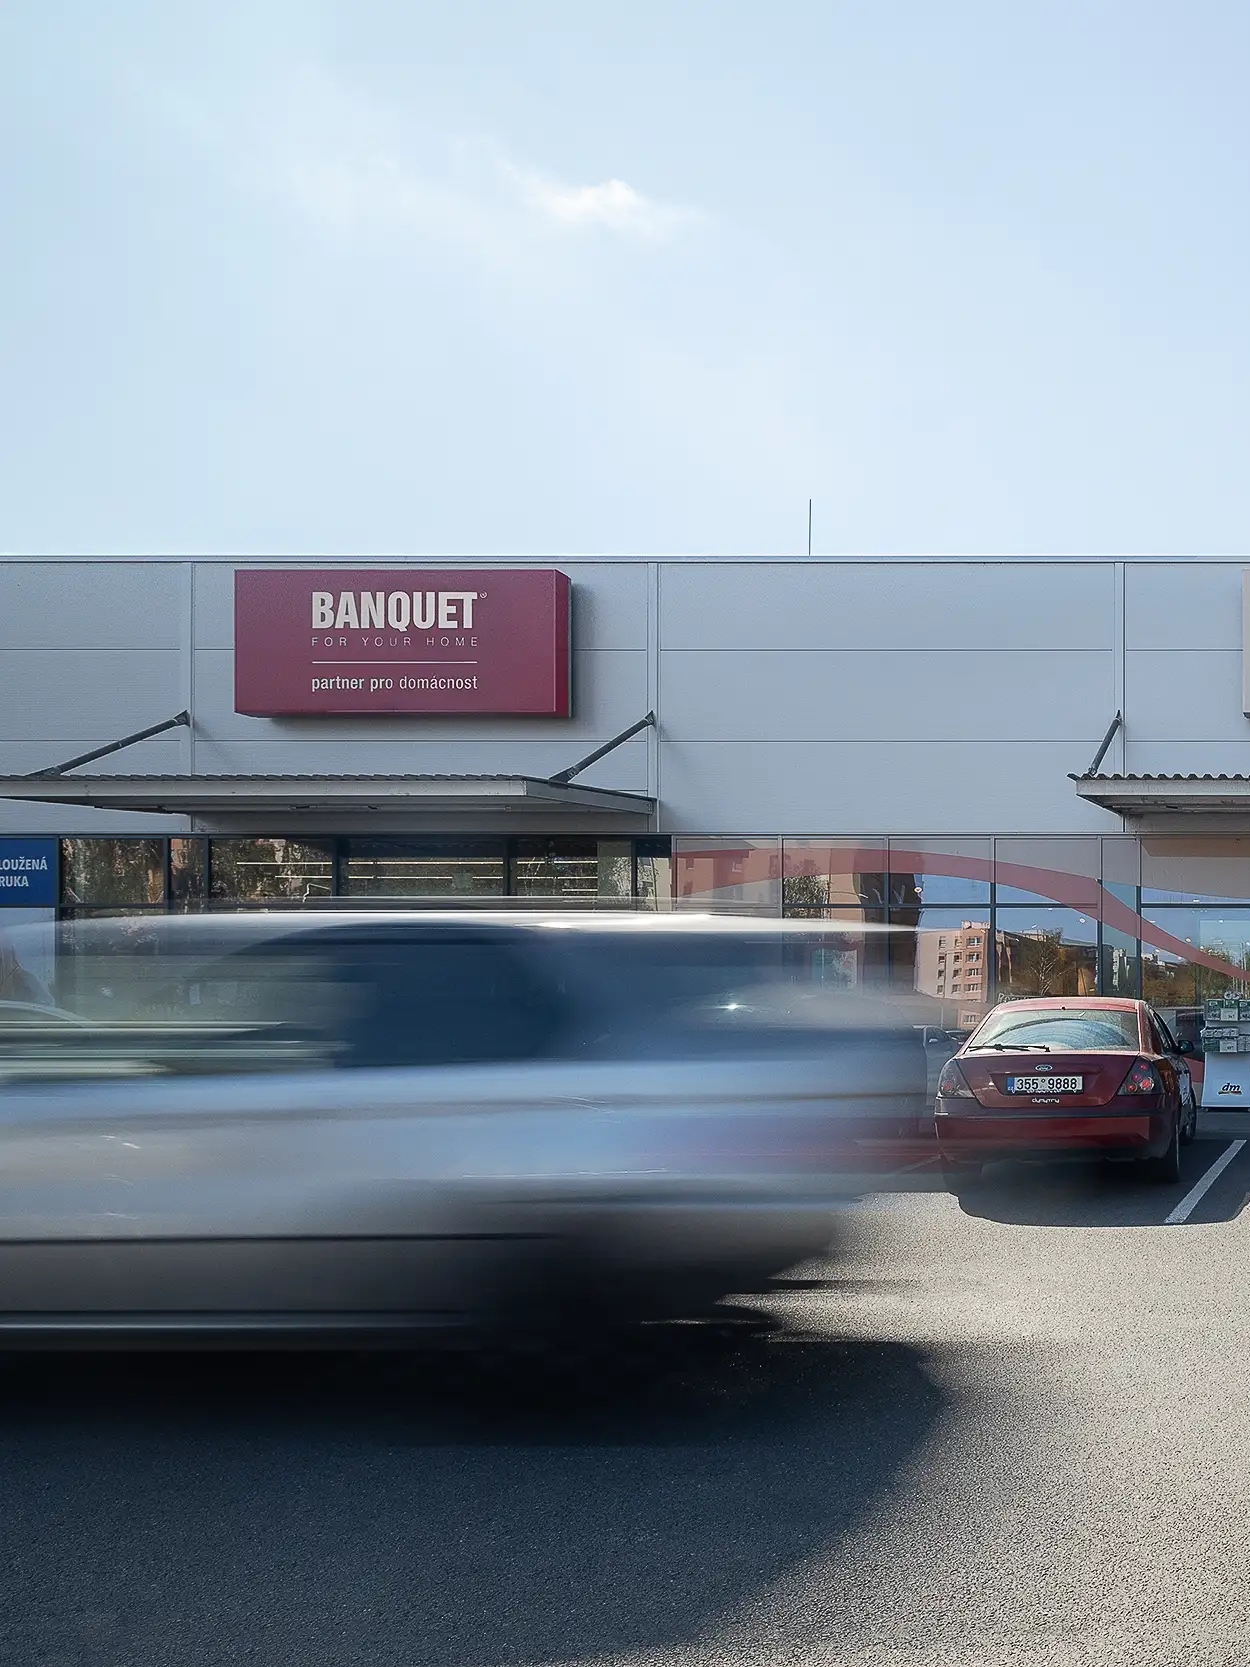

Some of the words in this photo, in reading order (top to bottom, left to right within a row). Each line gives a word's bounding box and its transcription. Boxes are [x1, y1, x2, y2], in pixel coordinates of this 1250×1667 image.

[311, 636, 348, 647] FOR
[361, 636, 412, 647] YOUR
[426, 636, 478, 647] HOME
[311, 676, 365, 692] partner
[370, 678, 394, 692] pro
[399, 674, 478, 690] domácnost
[1221, 1082, 1241, 1092] dm
